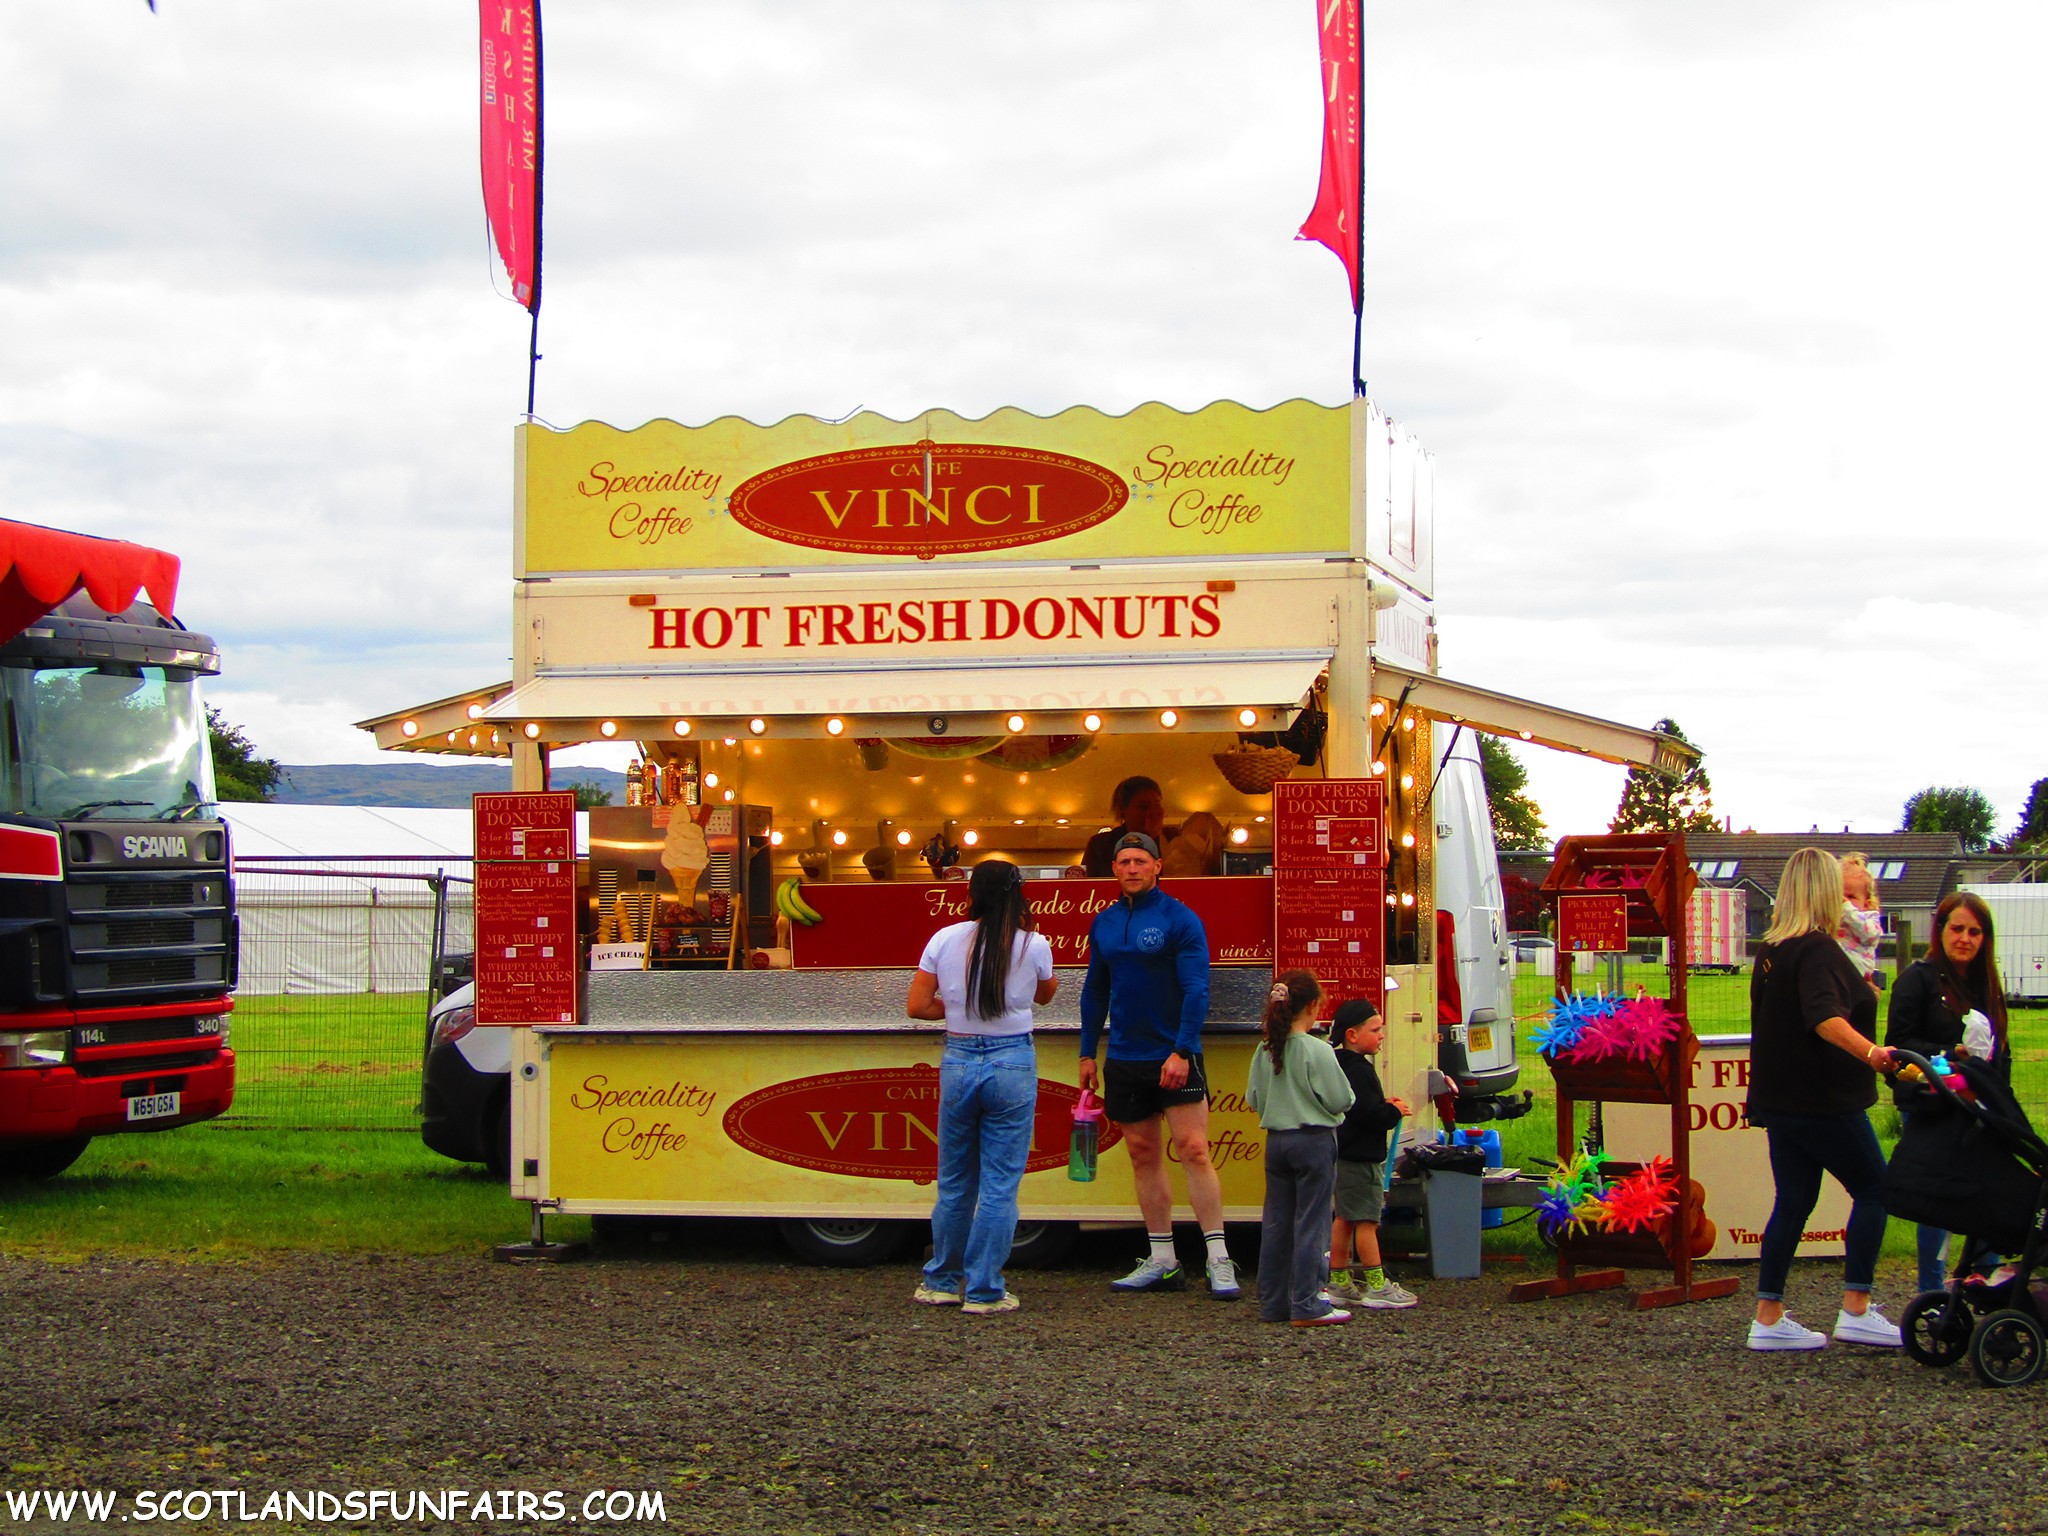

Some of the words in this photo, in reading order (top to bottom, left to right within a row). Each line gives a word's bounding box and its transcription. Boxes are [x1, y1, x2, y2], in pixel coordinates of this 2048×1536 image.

[890, 461, 962, 477] CAFE
[1133, 444, 1297, 487] Speciality
[578, 461, 722, 499] Speciality
[809, 484, 1045, 529] VINCI
[1168, 489, 1263, 535] Coffee
[608, 502, 693, 545] Coffee
[648, 607, 770, 650] HOT
[784, 599, 972, 648] FRESH
[979, 593, 1222, 641] DONUTS
[1278, 784, 1316, 798] HOT
[1321, 784, 1380, 797] FRESH
[478, 798, 512, 811] HOT
[517, 796, 571, 810] FRESH
[1287, 799, 1368, 814] DONUTS
[486, 810, 561, 826] DONUTS
[1281, 820, 1287, 829] 5
[1290, 820, 1304, 829] for
[481, 831, 487, 841] 5
[490, 831, 502, 841] for
[1281, 835, 1287, 845] 8
[1290, 835, 1304, 845] for
[124, 835, 188, 859] SCANIA
[481, 845, 487, 855] 8
[490, 845, 502, 855] for
[1279, 869, 1379, 880] HOT-WAFFLES
[478, 877, 571, 888] HOT-WAFFLES
[924, 889, 967, 917] Fre
[1022, 889, 1076, 915] ade
[1567, 900, 1588, 908] PICK
[1599, 899, 1618, 907] CUP
[1286, 928, 1312, 938] MR.
[1315, 927, 1372, 938] WHIPPY
[1598, 922, 1608, 930] IT
[486, 934, 509, 945] MR.
[511, 933, 564, 944] WHIPPY
[1580, 932, 1604, 940] WITH
[1574, 940, 1613, 949] SLUSH
[597, 951, 613, 961] ICE
[614, 951, 645, 960] CREAM
[1288, 958, 1331, 966] WHIPPY
[1333, 958, 1366, 966] MADE
[488, 962, 527, 971] WHIPPY
[530, 962, 560, 970] MADE
[480, 971, 573, 983] MILKSHAKES
[197, 1018, 219, 1033] 340
[571, 1074, 717, 1117] Speciality
[157, 1094, 174, 1112] GSA
[602, 1117, 688, 1161] Coffee
